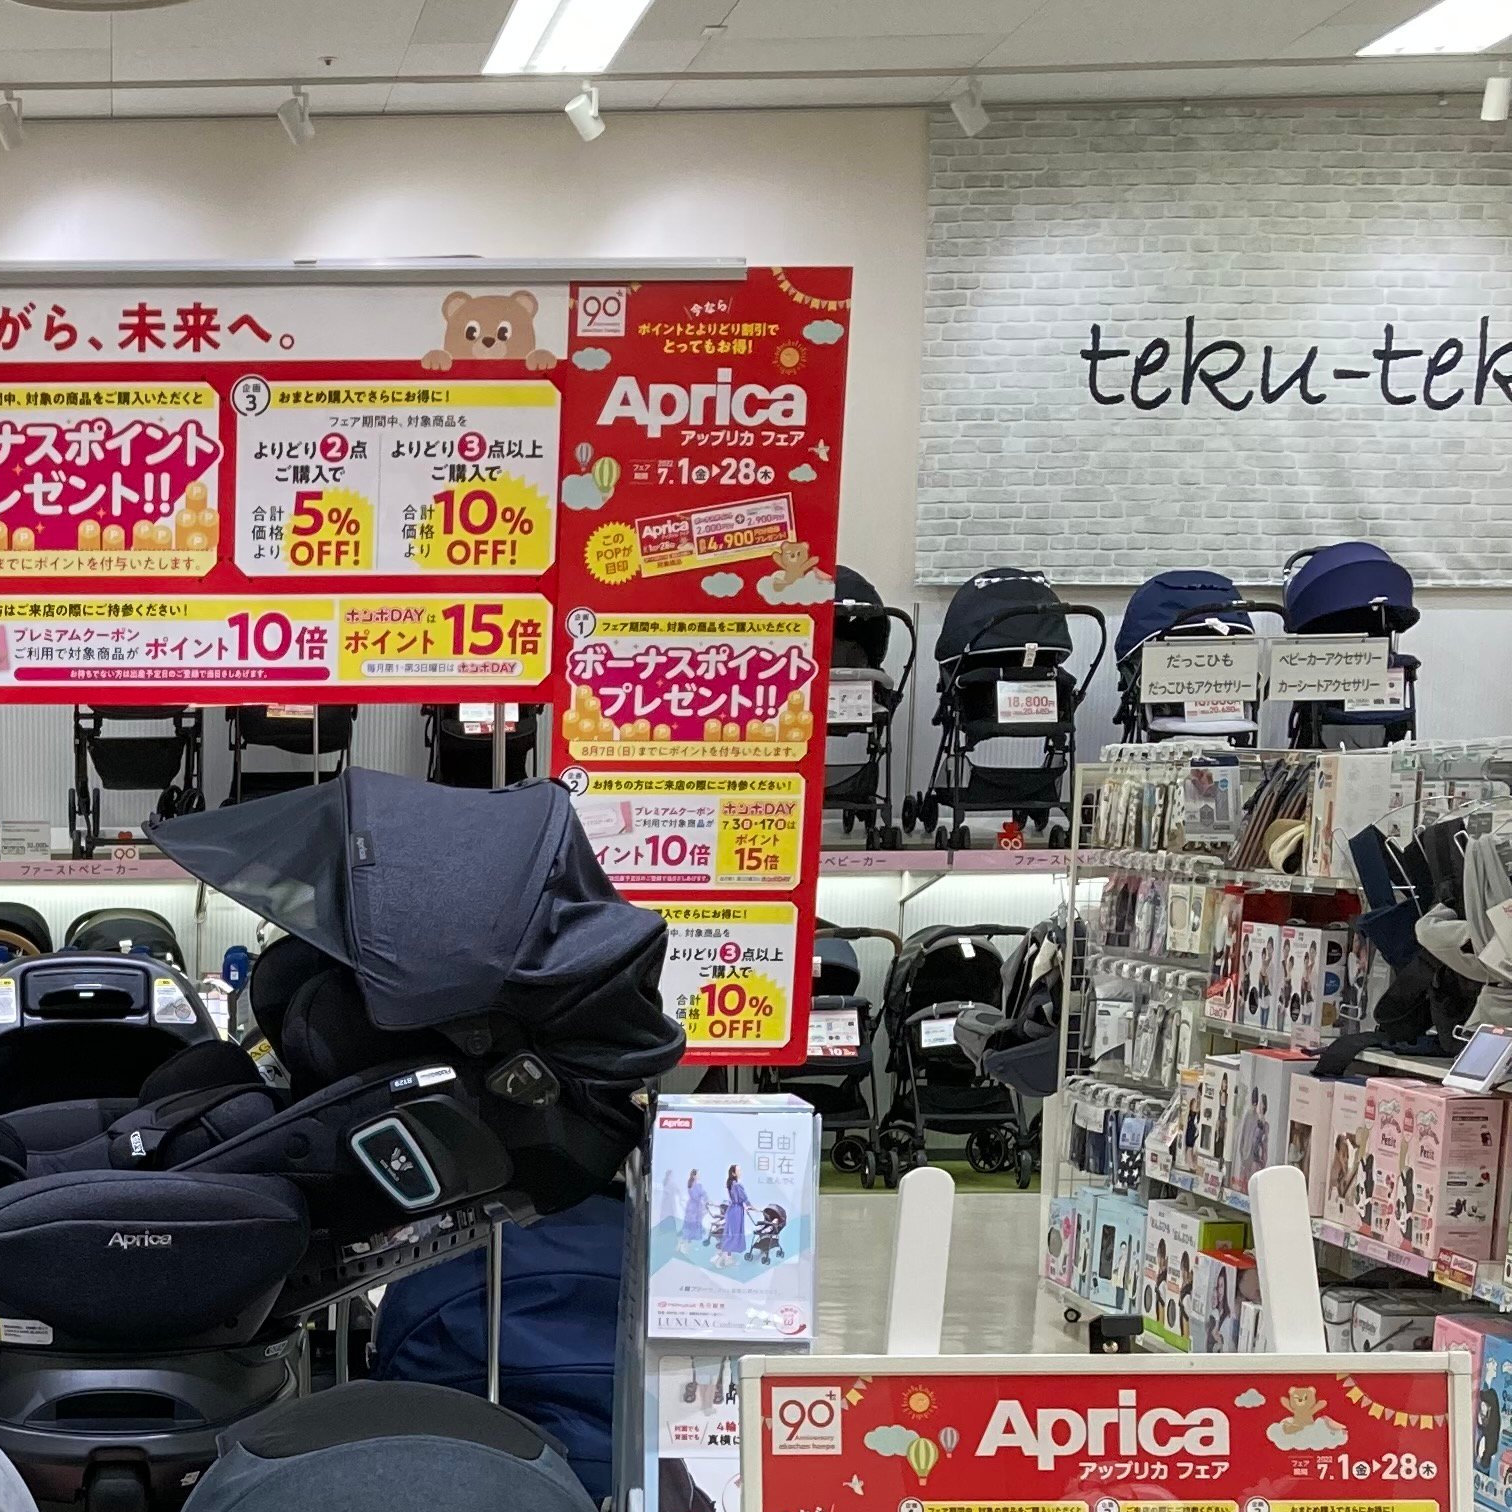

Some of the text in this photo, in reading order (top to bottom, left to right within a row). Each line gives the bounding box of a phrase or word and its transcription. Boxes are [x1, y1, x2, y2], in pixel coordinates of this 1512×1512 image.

[690, 300, 728, 316] 今なら
[637, 322, 779, 337] ポイントとよりどり割引で
[596, 367, 808, 438] Aprica
[328, 415, 468, 428] フェア期間中、対象商品を
[680, 429, 805, 447] アップリカ フェア
[275, 464, 346, 484] ご購入で
[430, 464, 502, 484] ご購入で
[291, 490, 361, 537] 5%
[432, 489, 534, 536] 10%
[641, 519, 689, 540] Aprica
[602, 532, 625, 546] この
[289, 540, 361, 567] OFF!
[446, 539, 518, 566] OFF!
[596, 545, 634, 561] POPが
[605, 560, 629, 575] 目印
[13, 628, 140, 644] プレミアムクーポン
[13, 646, 140, 662] ご利用で対象商品が
[1166, 653, 1235, 668] だっこひも
[1278, 651, 1382, 665] ベビーカーアクセサリー
[573, 647, 812, 681] ボーナスポイント
[1148, 680, 1252, 694] だっこひもアクセサリー
[1277, 679, 1380, 693] カーシートアクセサリー
[735, 833, 780, 846] ポイント
[20, 863, 139, 877] ファーストベビーカー
[698, 965, 752, 980] ご購入で
[699, 983, 774, 1018] 10%
[708, 1019, 763, 1039] OFF!
[107, 1229, 173, 1249] Aprica
[974, 1389, 1230, 1471] Aprica
[1078, 1461, 1230, 1481] アップリカ フェア
